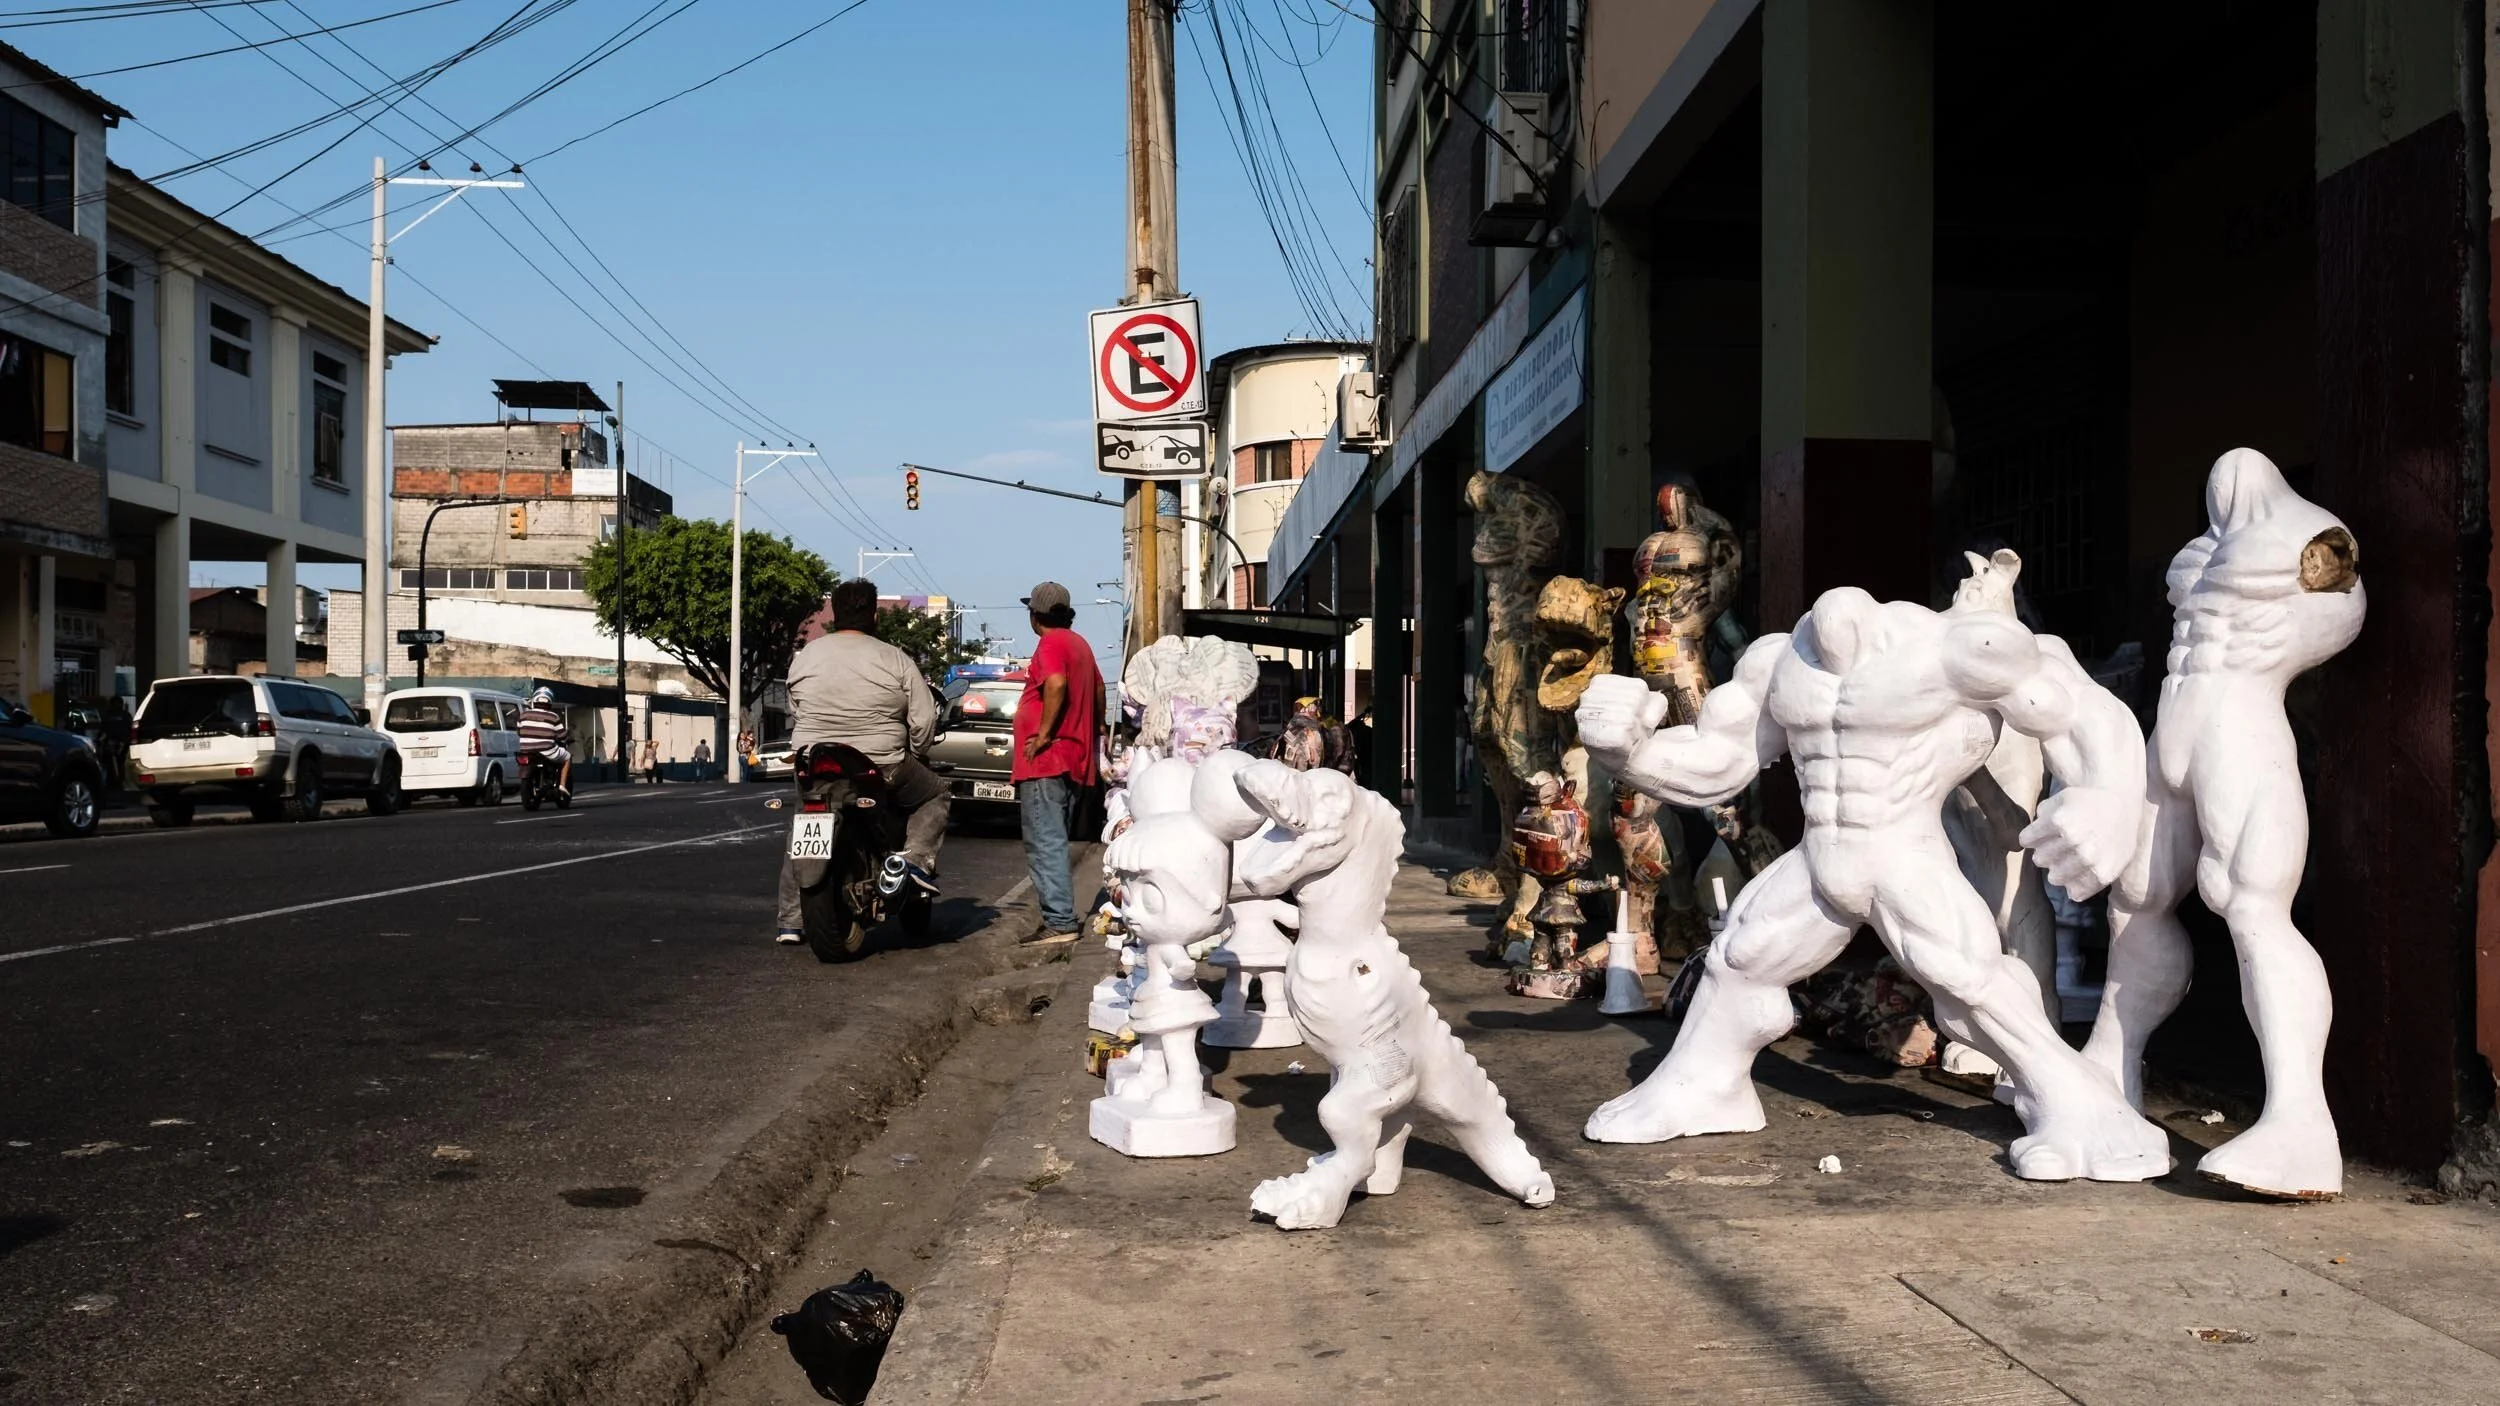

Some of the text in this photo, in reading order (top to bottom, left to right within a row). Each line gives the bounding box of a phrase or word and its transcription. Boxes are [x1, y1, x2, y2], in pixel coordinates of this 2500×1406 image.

[1127, 332, 1170, 395] E
[1504, 317, 1571, 407] DISTRIBUIDORA
[793, 840, 830, 856] 370X
[803, 822, 821, 838] AA
